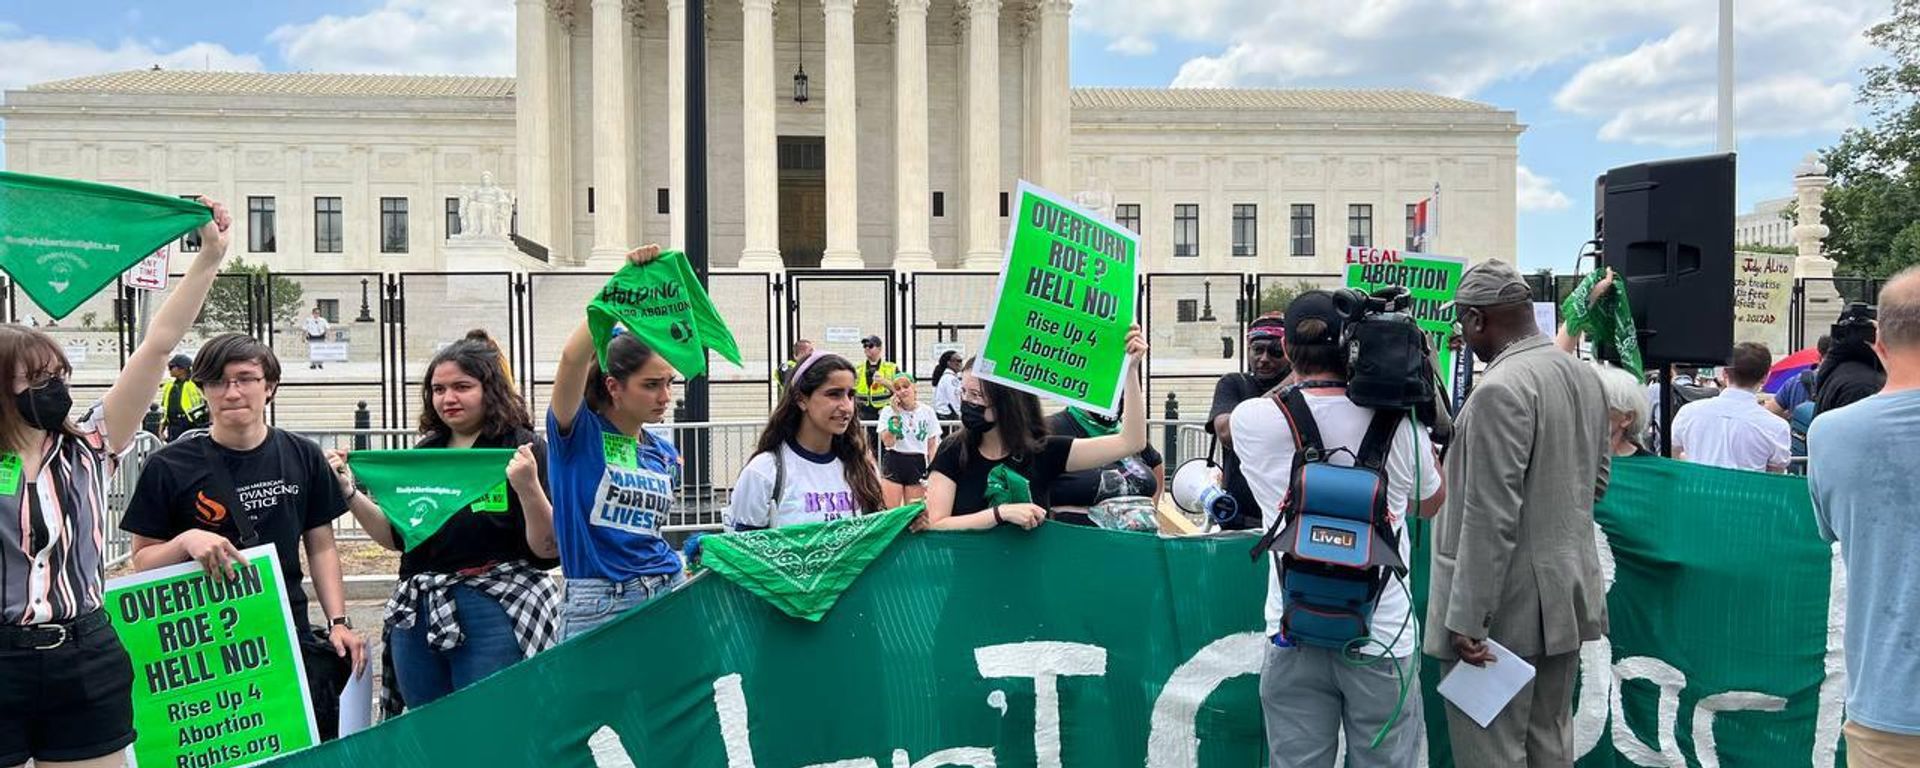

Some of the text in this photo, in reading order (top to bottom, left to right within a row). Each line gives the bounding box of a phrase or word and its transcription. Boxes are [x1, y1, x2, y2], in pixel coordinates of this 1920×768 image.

[1033, 202, 1126, 263] OVERTURN
[1049, 240, 1107, 283] ROE ?
[1346, 247, 1403, 264] LEGAL
[1026, 267, 1117, 321] HELL NO!
[1360, 264, 1449, 291] ABORTION
[1026, 310, 1098, 347] Rise Up 4
[1020, 335, 1088, 370] Abortion
[1009, 356, 1089, 398] Rights.org
[606, 485, 643, 508] FOR
[609, 471, 668, 495] MARCH
[600, 502, 654, 529] LIVES
[1312, 531, 1353, 547] LiveU
[119, 564, 263, 623] OVERTURN
[158, 607, 240, 653] ROE ?
[145, 636, 271, 694] HELL NO!
[167, 682, 263, 723] Rise Up 4
[177, 711, 264, 748] Abortion
[175, 732, 281, 768] Rights.org
